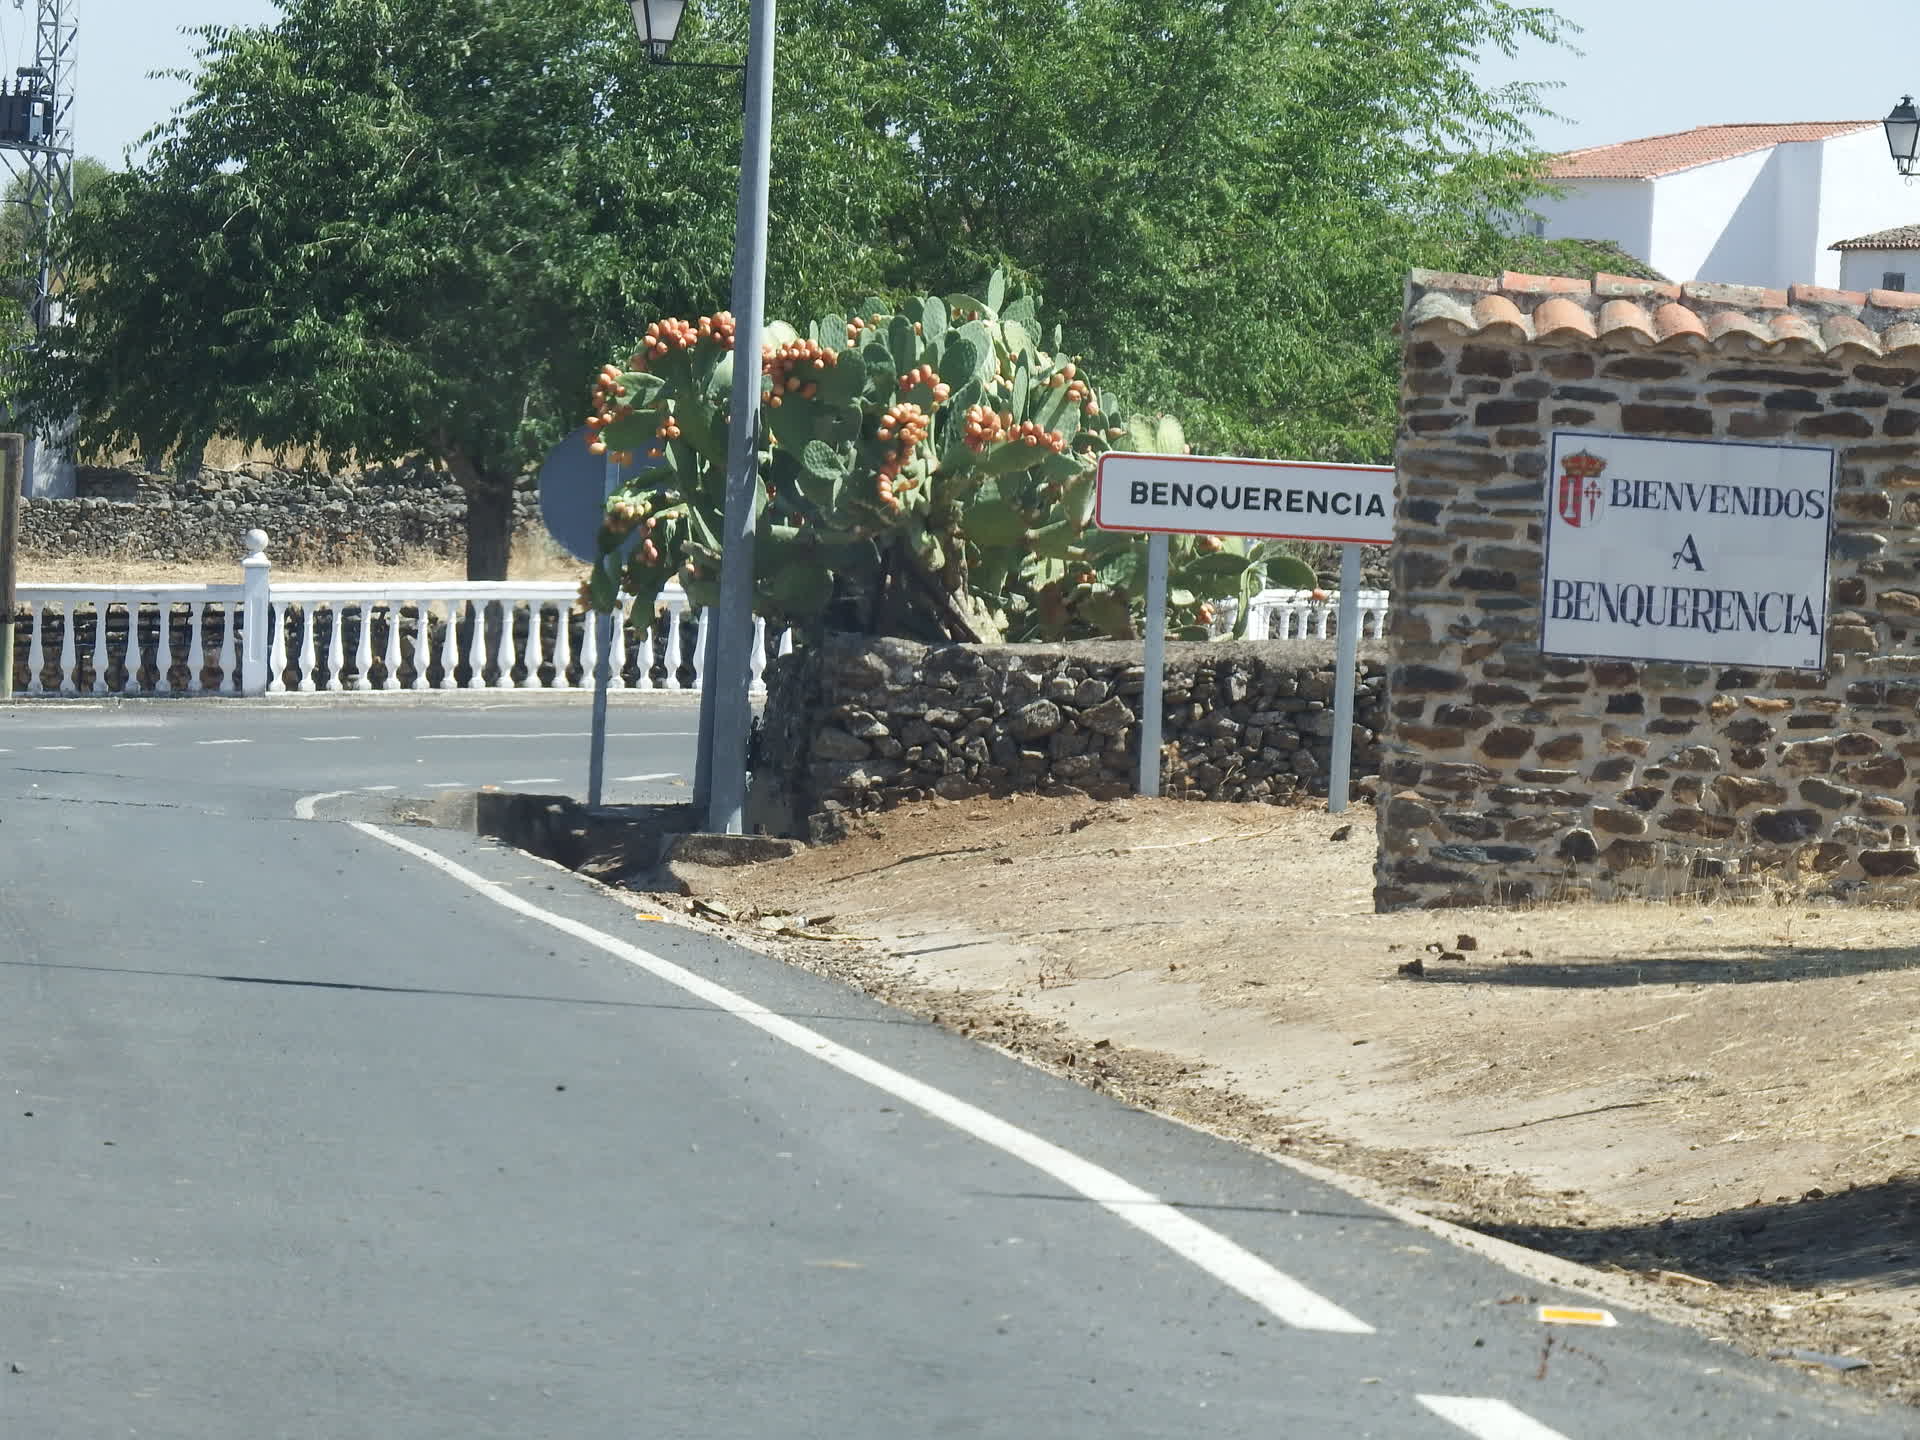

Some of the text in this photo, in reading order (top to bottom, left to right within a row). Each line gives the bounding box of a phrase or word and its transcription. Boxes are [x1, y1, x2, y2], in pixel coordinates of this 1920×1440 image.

[1130, 480, 1386, 517] BENQUERENCIA
[1609, 478, 1825, 519] BIENVENIDOS
[1672, 533, 1705, 571] A
[1551, 579, 1820, 636] BENQUERENCIA
